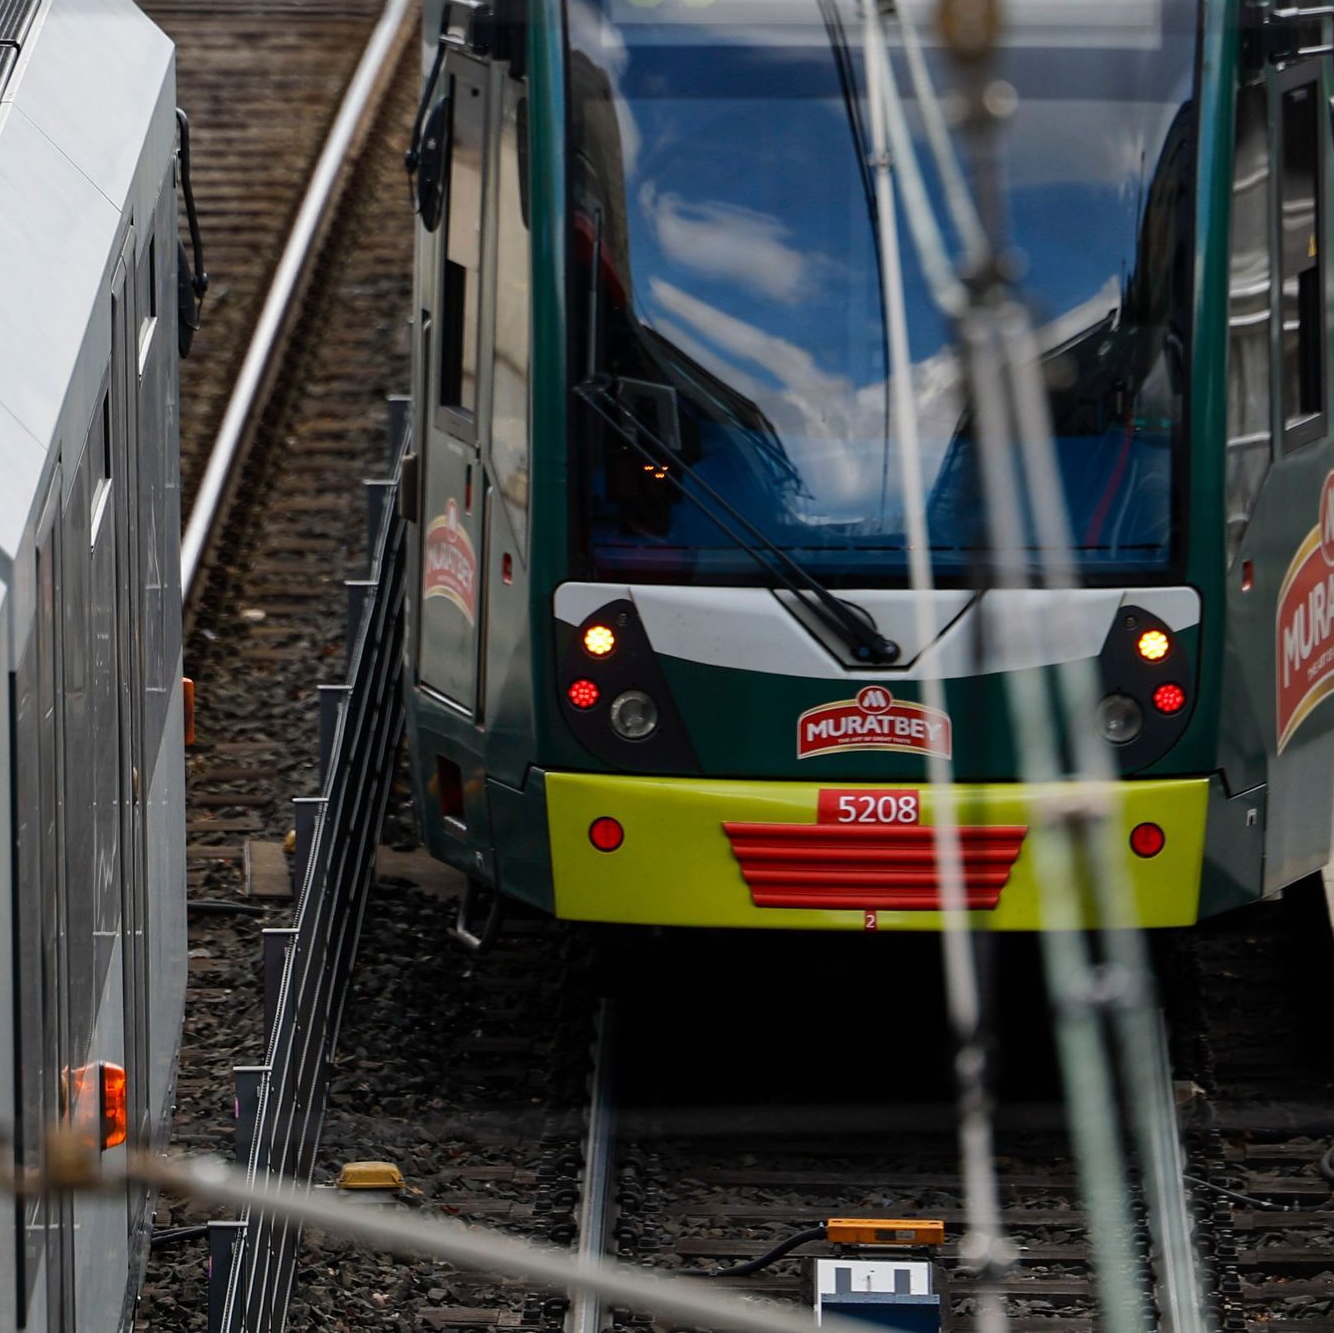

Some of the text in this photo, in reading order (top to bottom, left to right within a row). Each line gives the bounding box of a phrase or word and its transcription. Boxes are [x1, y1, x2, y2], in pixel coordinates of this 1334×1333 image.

[806, 715, 943, 742] MURATBEY
[838, 796, 918, 823] 5208
[866, 915, 876, 928] 2
